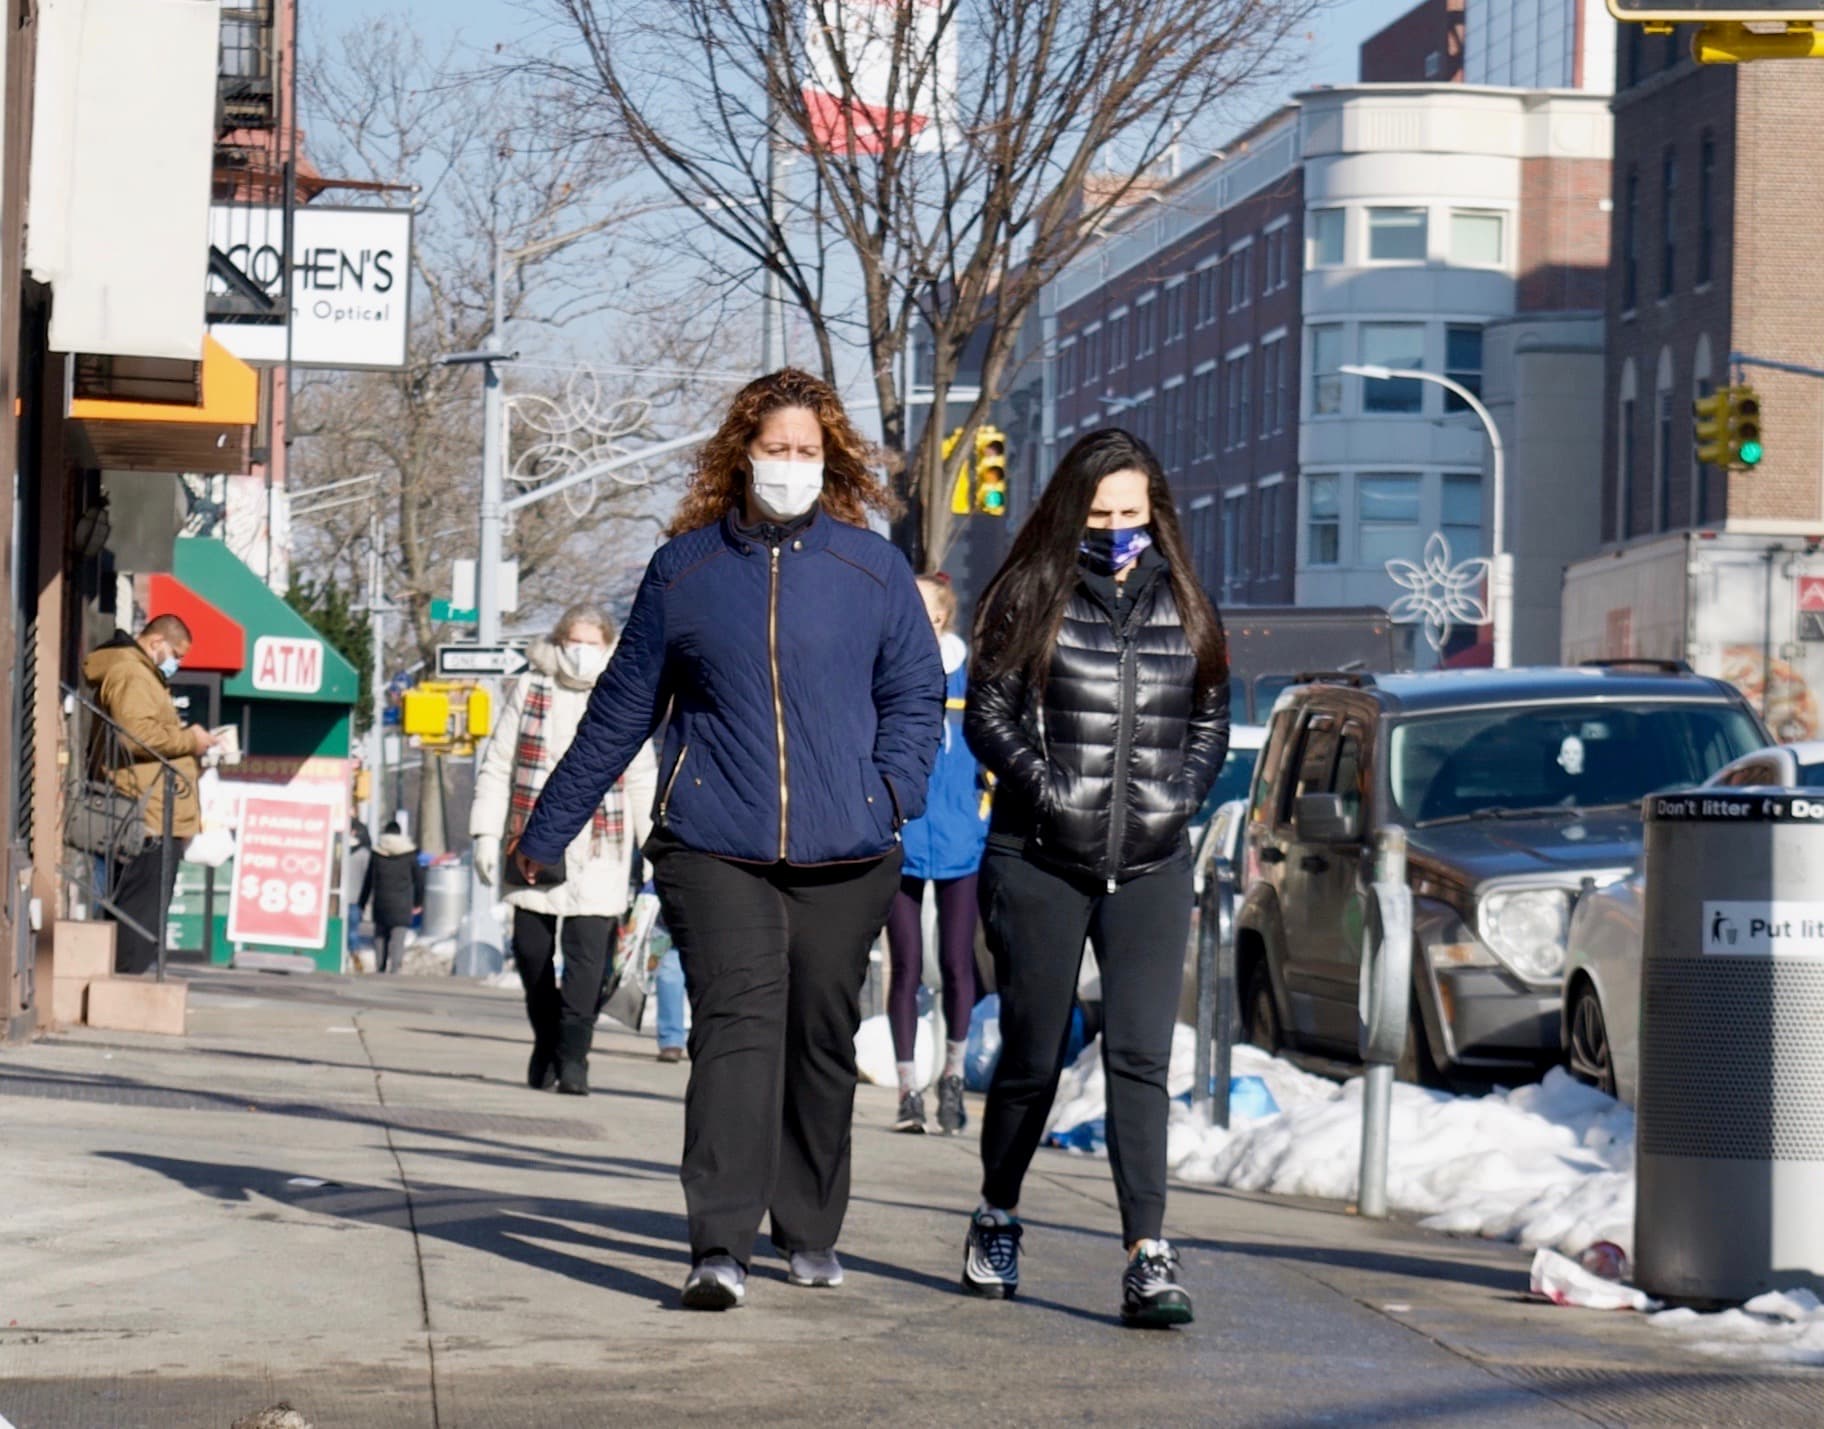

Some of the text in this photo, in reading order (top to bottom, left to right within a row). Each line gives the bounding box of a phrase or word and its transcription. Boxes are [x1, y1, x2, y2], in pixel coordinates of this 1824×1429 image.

[312, 300, 390, 322] Optical
[260, 644, 317, 686] ATM
[451, 655, 475, 666] ONE
[1657, 800, 1697, 815] Don't
[1702, 800, 1751, 816] litter
[243, 852, 278, 869] FOR
[240, 874, 318, 916] $89
[1750, 919, 1792, 938] Put
